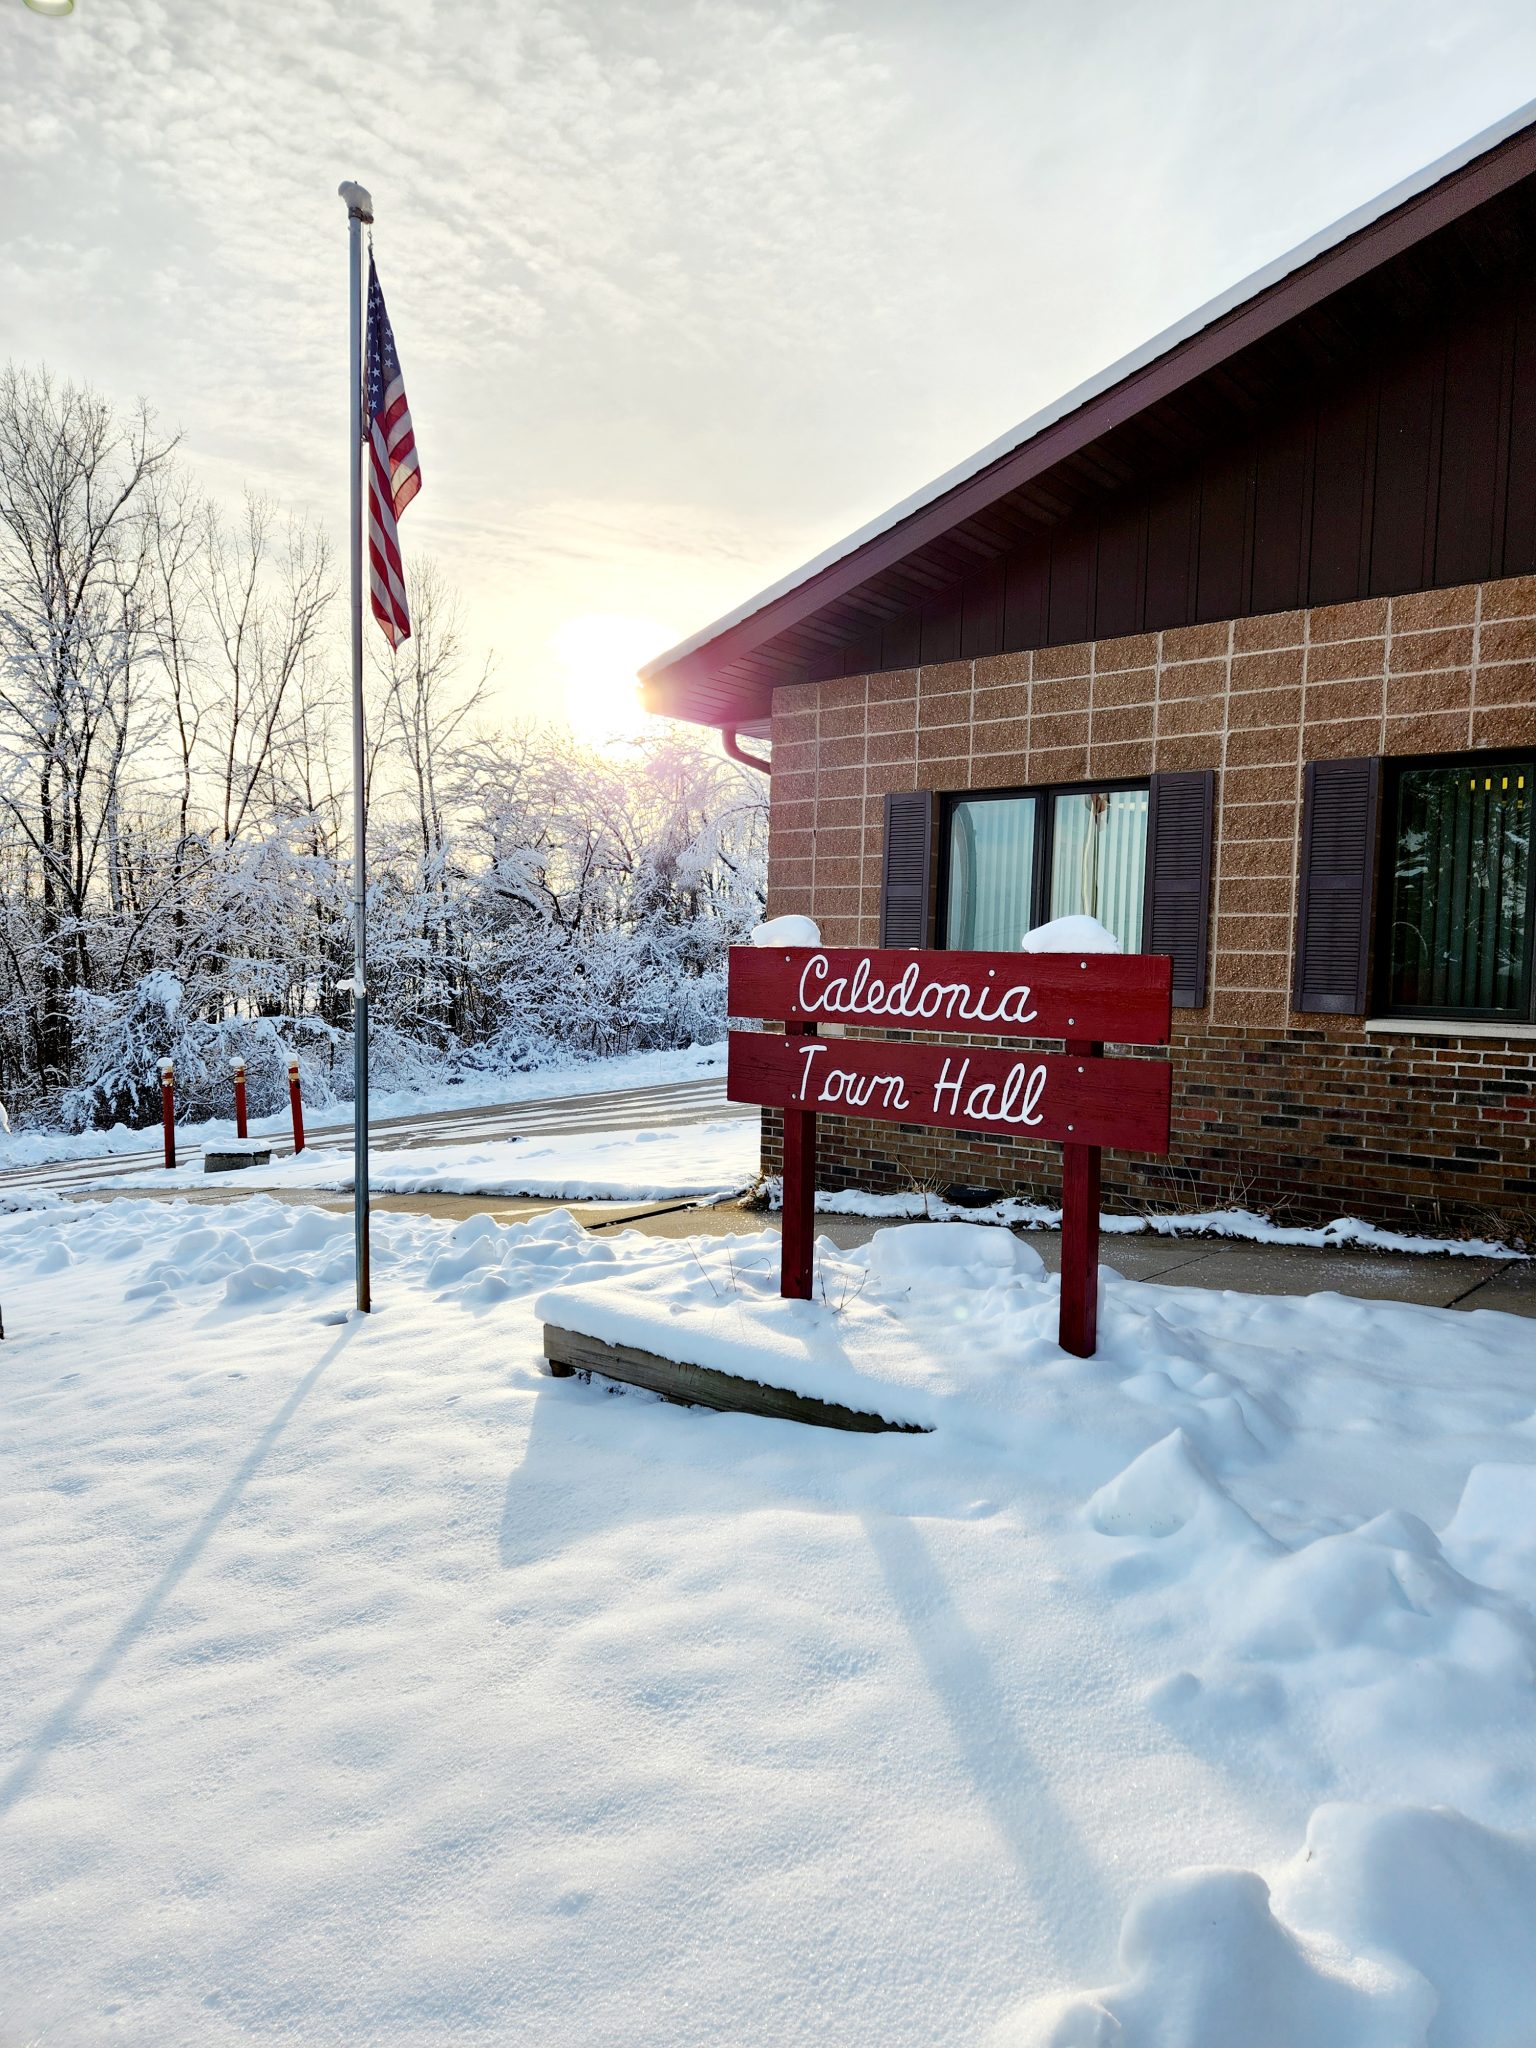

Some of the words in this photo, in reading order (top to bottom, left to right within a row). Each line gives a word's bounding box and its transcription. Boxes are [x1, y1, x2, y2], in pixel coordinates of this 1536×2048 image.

[799, 954, 1038, 1022] Caledonia
[799, 1044, 909, 1110] Town
[933, 1057, 1047, 1125] Hall
